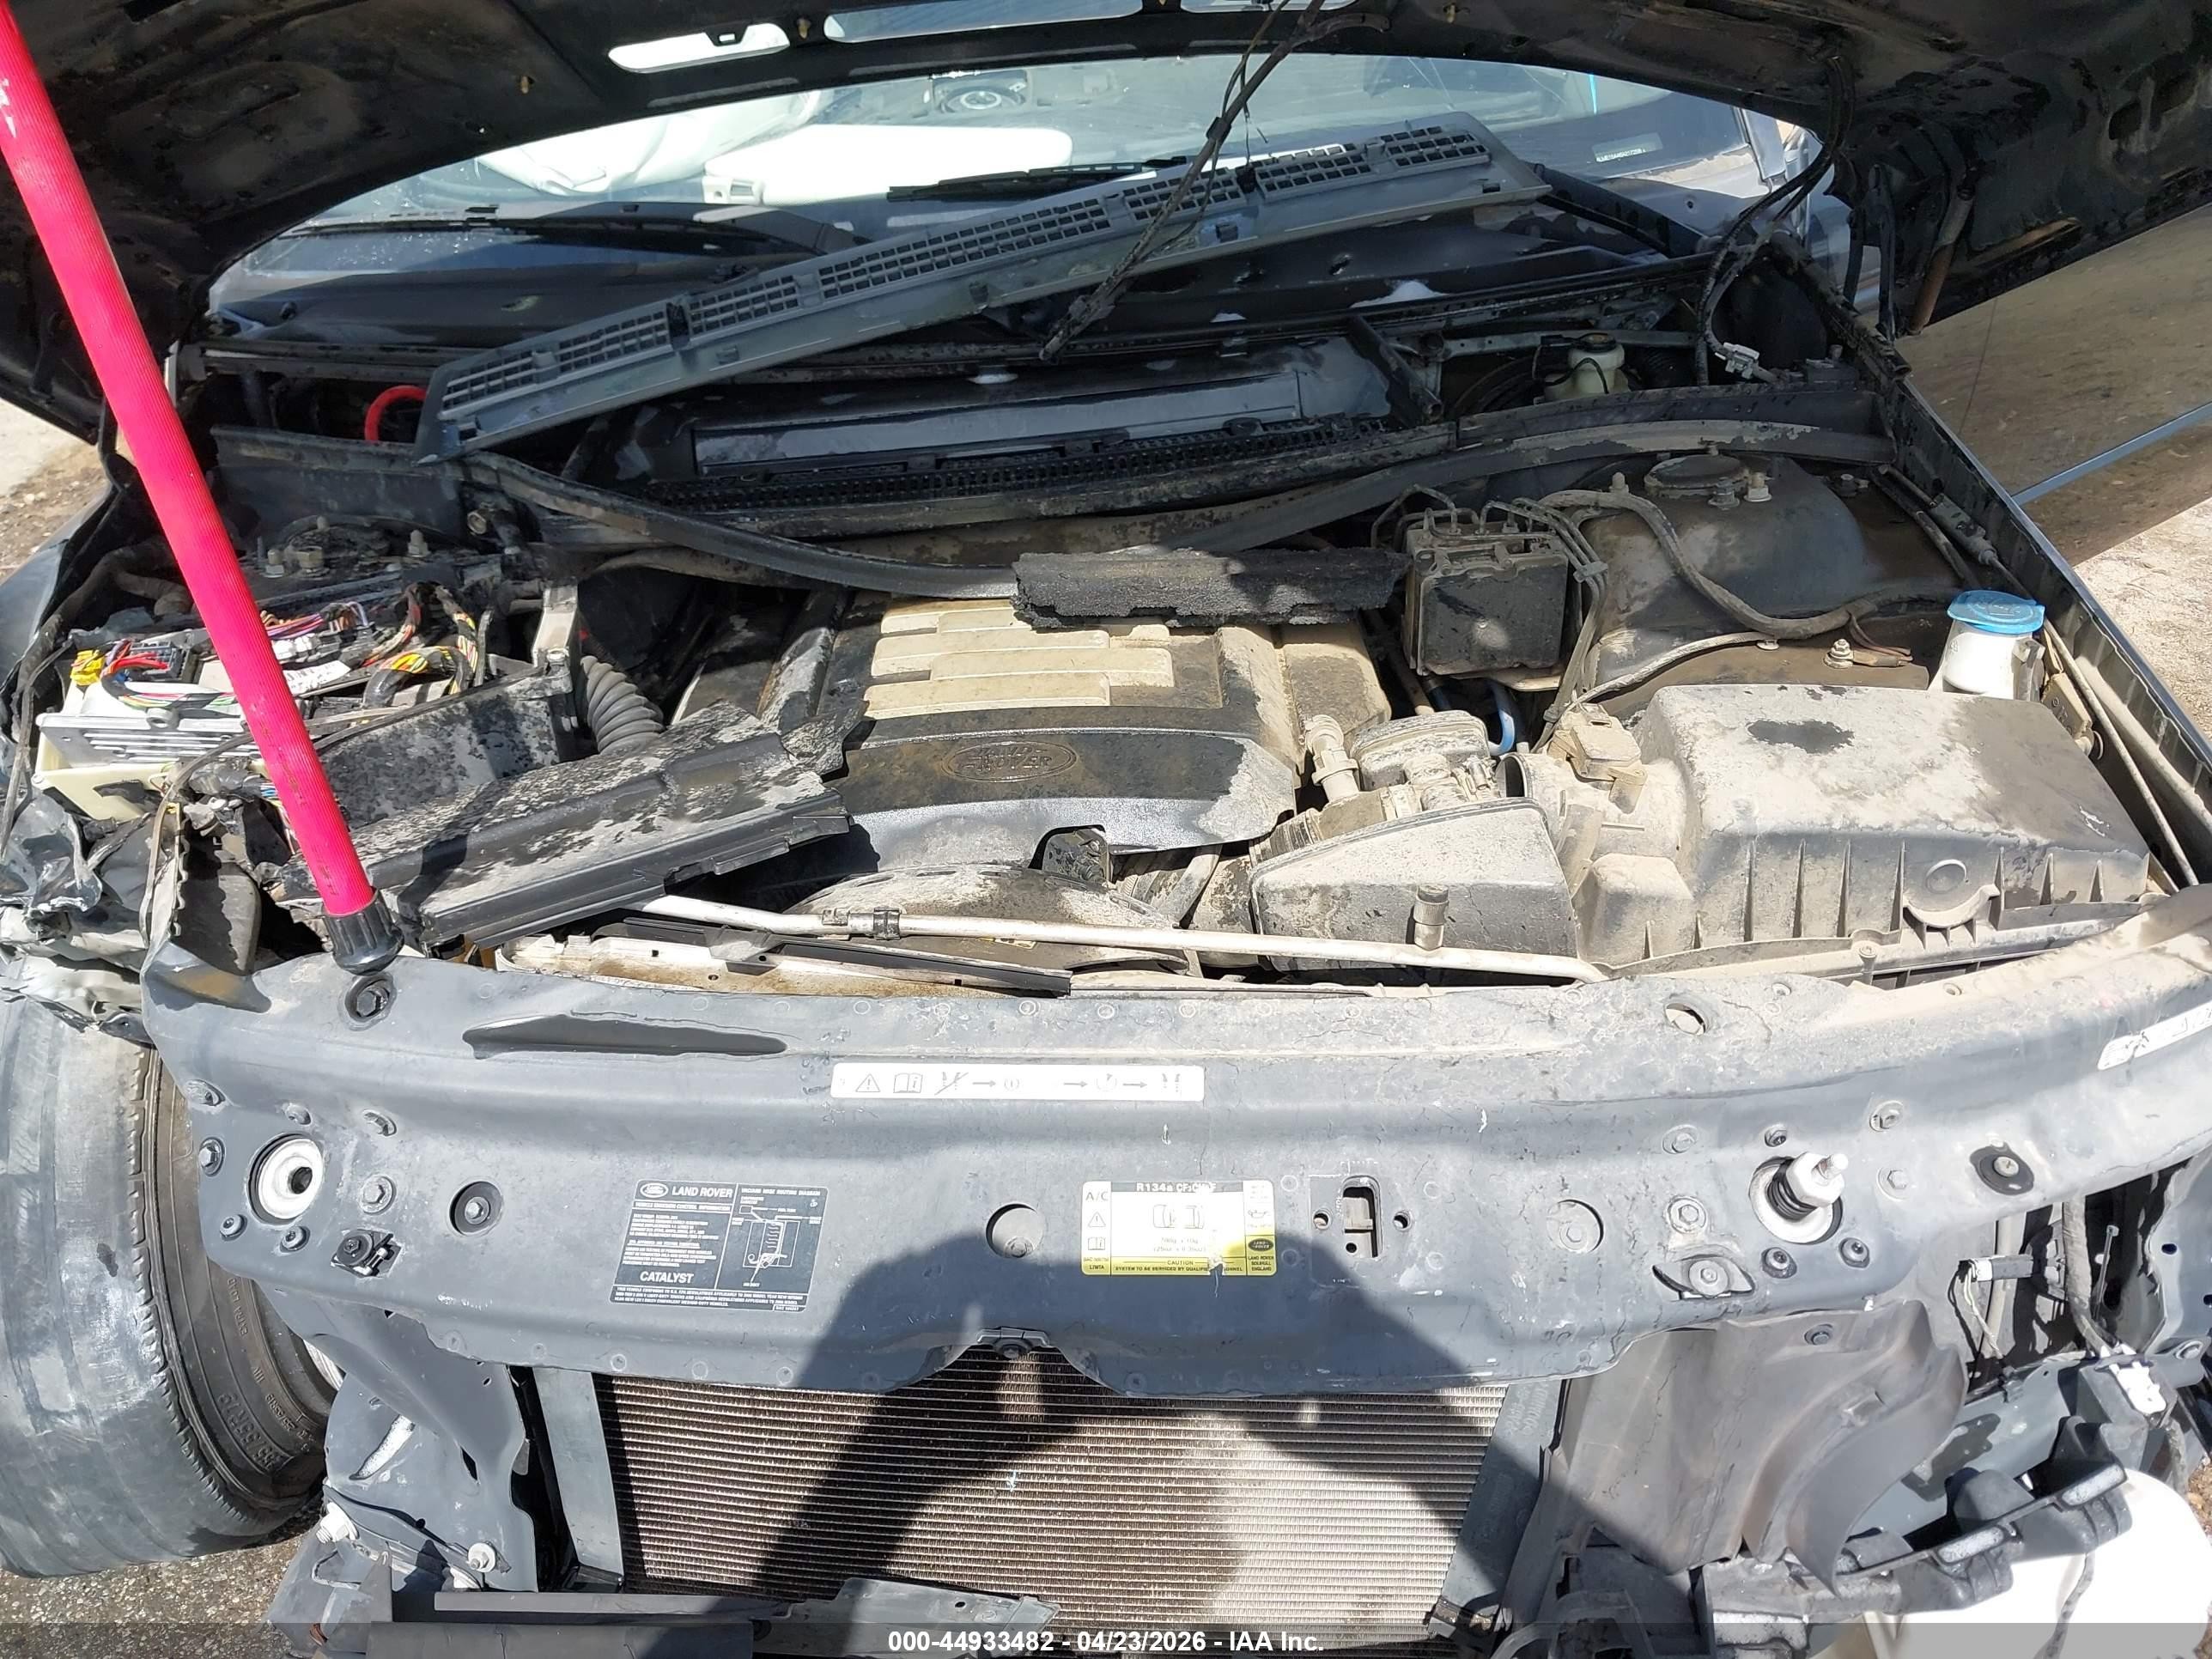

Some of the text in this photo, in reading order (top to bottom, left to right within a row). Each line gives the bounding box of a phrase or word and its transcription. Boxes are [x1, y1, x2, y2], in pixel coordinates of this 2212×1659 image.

[977, 756, 1052, 770] ROVER
[672, 1186, 699, 1196] LAND
[699, 1187, 733, 1198] ROVER
[1136, 1182, 1173, 1192] R134a
[1085, 1192, 1109, 1201] A/C
[639, 1270, 695, 1284] CATALYST
[226, 1277, 248, 1337] EXTRA LOAD
